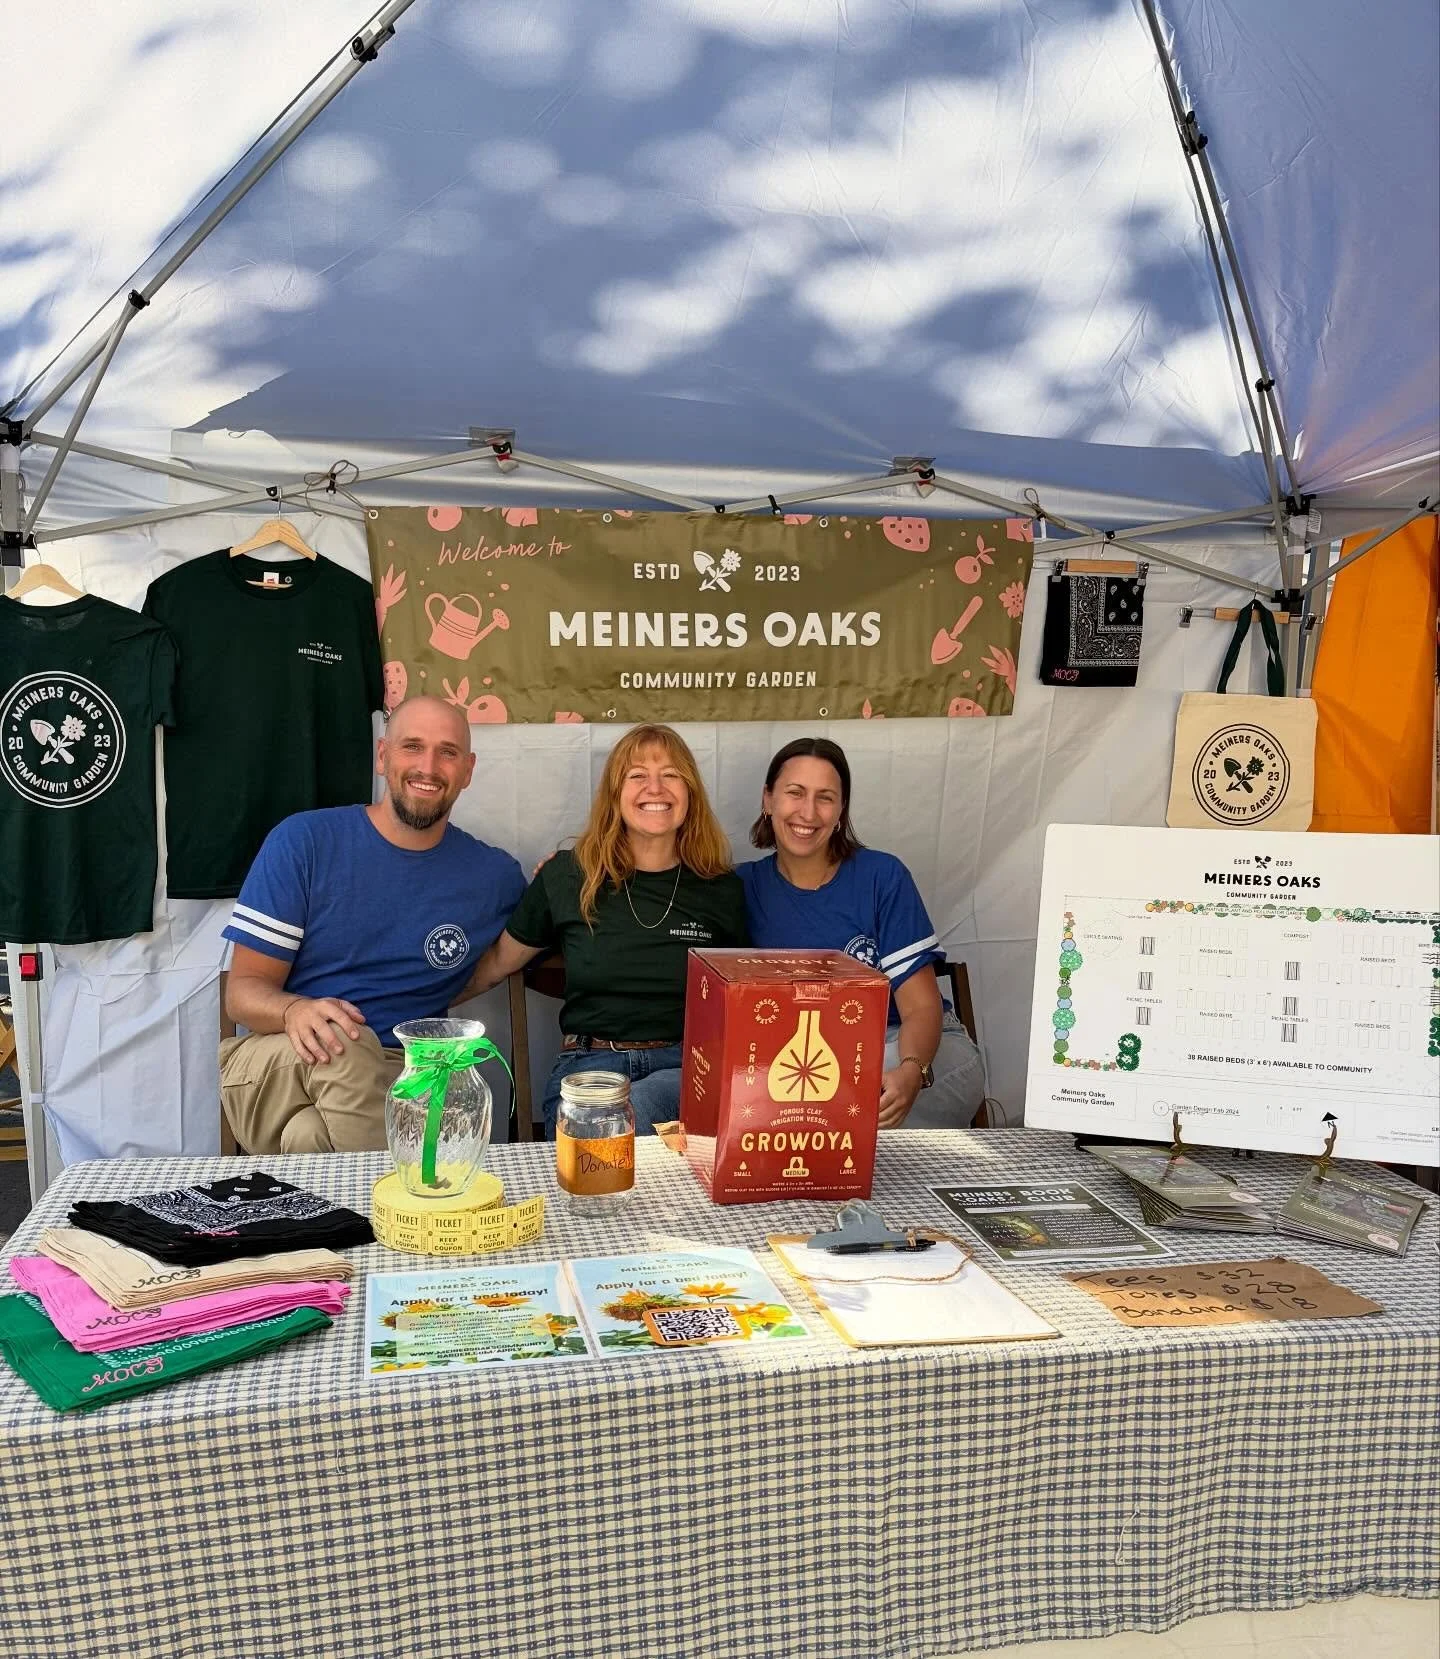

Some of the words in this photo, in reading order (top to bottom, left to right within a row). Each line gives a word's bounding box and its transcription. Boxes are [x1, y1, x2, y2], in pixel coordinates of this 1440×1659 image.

[438, 536, 543, 565] Welcome
[548, 536, 572, 557] to
[633, 563, 681, 580] ESTD
[754, 565, 801, 582] 2023
[549, 611, 748, 648] MEINERS
[762, 611, 882, 648] OAKS
[619, 671, 736, 689] COMMUNITY
[745, 670, 817, 688] GARDEN
[12, 686, 64, 721] MEINERS
[69, 690, 103, 720] OAKS
[8, 736, 24, 750] 20
[93, 734, 111, 748] 23
[1211, 735, 1251, 758] MEINERS
[1253, 738, 1276, 761] OAKS
[12, 754, 68, 794] COMMUNITY
[73, 752, 109, 789] GARDEN
[1203, 769, 1217, 779] 20
[1267, 771, 1280, 781] 23
[1205, 782, 1247, 815] COMMUNITY
[1250, 785, 1277, 812] GARDEN
[1204, 872, 1272, 886] MEINERS
[1276, 875, 1321, 888] OAKS
[1226, 891, 1267, 899] COMMUNITY
[754, 998, 780, 1013] CONSERVE
[755, 1013, 778, 1025] WATER
[746, 1042, 757, 1087] GROW
[854, 1042, 863, 1085] EASY
[1197, 1054, 1224, 1063] RAISED
[1225, 1056, 1246, 1065] BEDS
[1272, 1060, 1313, 1070] AVAILABLE
[1326, 1064, 1373, 1074] COMMUNITY
[1060, 1088, 1087, 1097] Meiners
[1088, 1091, 1106, 1099] Oaks
[1051, 1094, 1089, 1105] Community
[1090, 1098, 1115, 1107] Garden
[779, 1107, 804, 1116] POROUS
[770, 1115, 804, 1127] IRRIGATION
[806, 1115, 829, 1127] VESSEL
[741, 1131, 853, 1152] GROWOYA
[577, 1147, 631, 1174] Donate!
[1018, 1188, 1075, 1197] BOOK
[519, 1203, 538, 1218] TICKET
[396, 1213, 419, 1226] TICKET
[435, 1218, 463, 1228] TICKET
[480, 1213, 505, 1226] TICKET
[522, 1222, 535, 1231] KEEP
[483, 1232, 501, 1240] KEEP
[518, 1229, 538, 1241] COUPON
[395, 1240, 419, 1249] COUPON
[478, 1240, 505, 1249] COUPON
[417, 1282, 477, 1291] MEINERS
[481, 1279, 519, 1287] OAKS
[595, 1281, 634, 1290] Apply
[638, 1279, 657, 1287] for
[390, 1298, 431, 1307] Apply
[435, 1295, 454, 1303] for
[504, 1288, 549, 1298] today!
